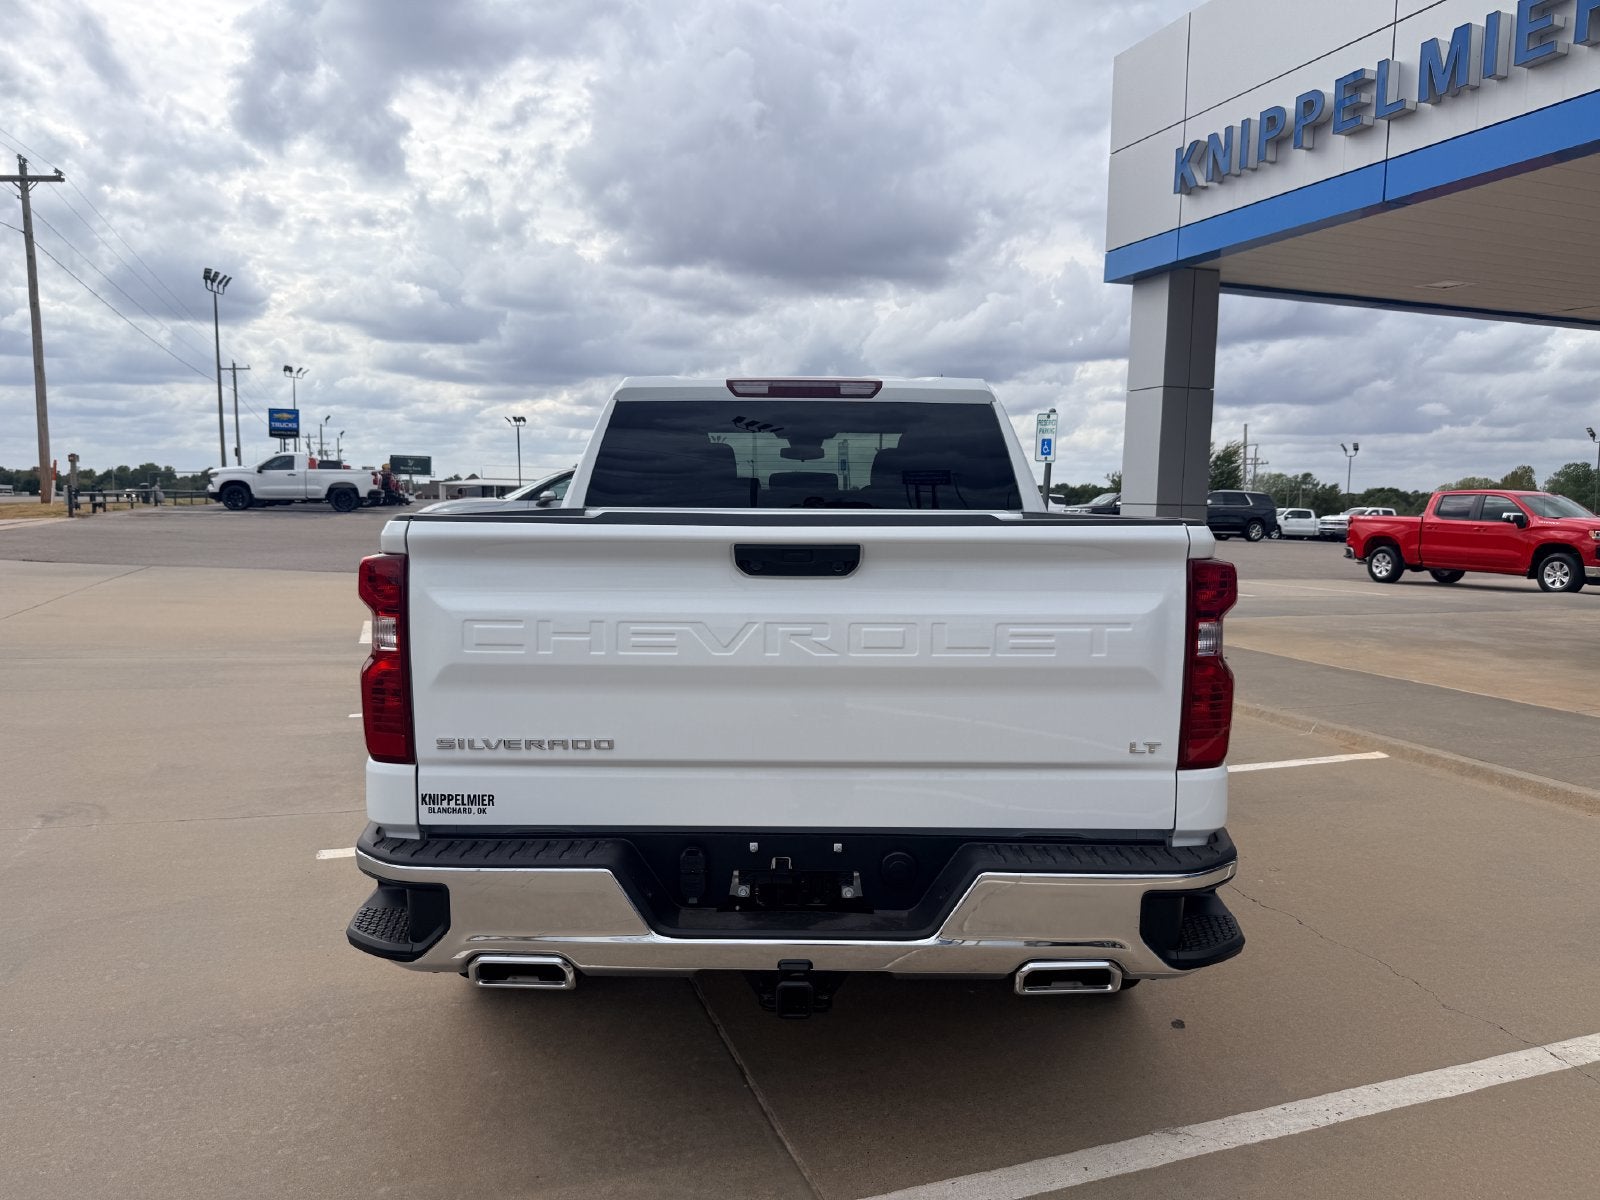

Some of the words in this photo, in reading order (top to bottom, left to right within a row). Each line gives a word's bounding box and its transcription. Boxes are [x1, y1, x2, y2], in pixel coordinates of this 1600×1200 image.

[463, 619, 1132, 658] CHEVROLET
[436, 738, 615, 751] SILVERADO
[1129, 741, 1162, 753] LT
[420, 793, 495, 806] KNIPPELMIER
[427, 807, 476, 815] BLANCHARD,
[477, 807, 488, 815] OK
